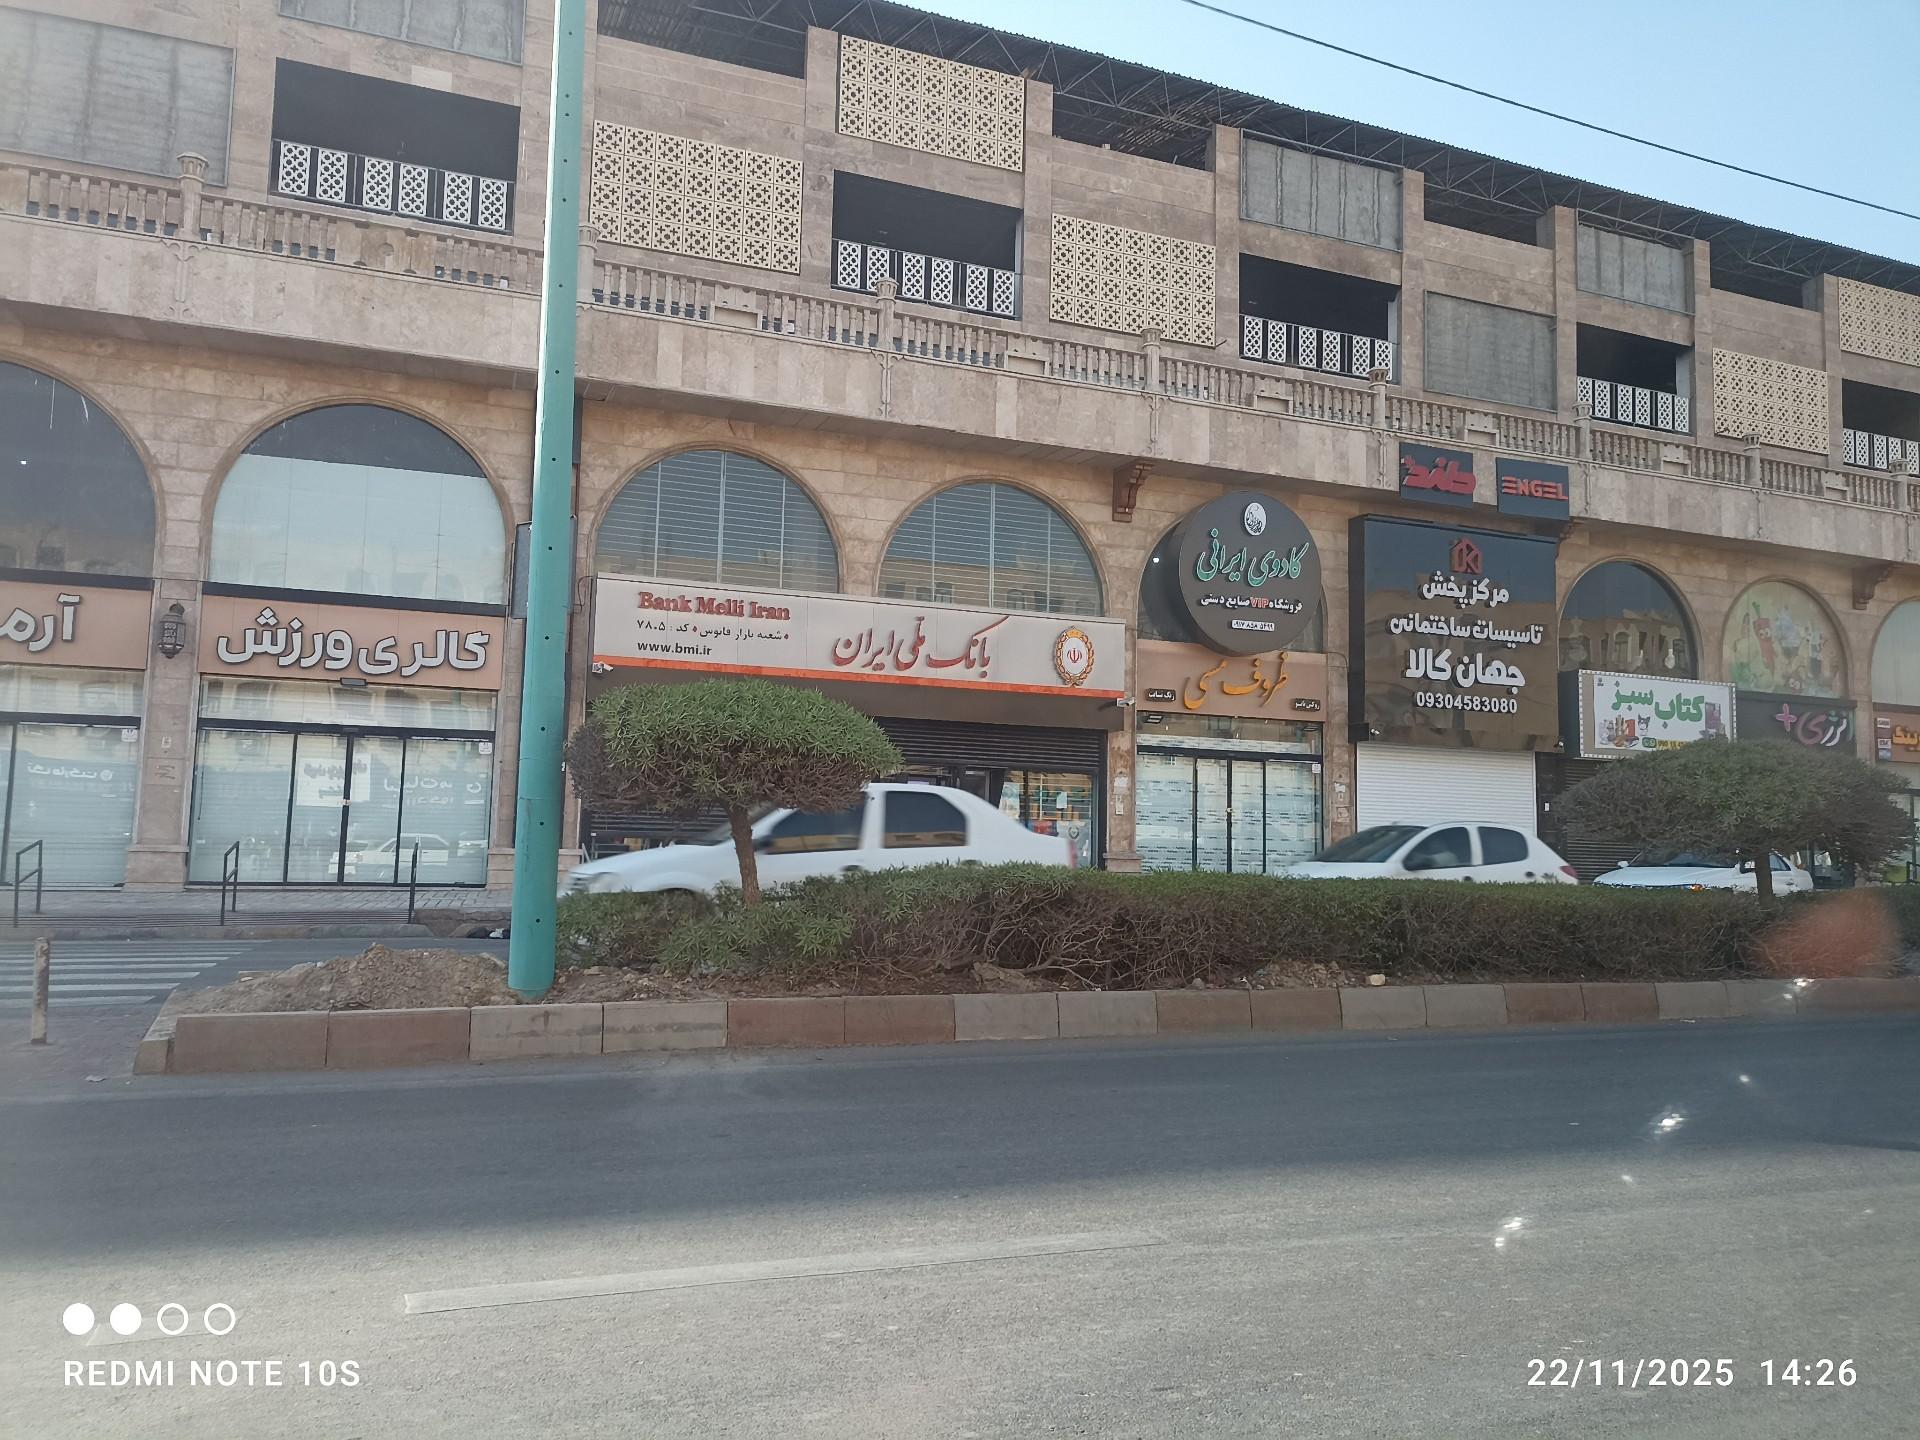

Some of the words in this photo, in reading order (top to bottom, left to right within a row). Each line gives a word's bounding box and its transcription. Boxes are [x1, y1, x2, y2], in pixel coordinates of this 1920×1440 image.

[1502, 476, 1569, 500] ENGEL
[1197, 528, 1247, 581] ایرانی
[1247, 542, 1310, 587] کادوی
[1201, 593, 1225, 605] دستی
[1422, 570, 1468, 608] پخش
[1469, 578, 1510, 607] مرکز
[637, 591, 692, 613] Bank
[694, 596, 745, 618] Melli
[748, 601, 791, 621] Iran
[1269, 598, 1302, 613] فروشگاه
[0, 592, 81, 652] آرم
[676, 623, 689, 632] کد
[699, 626, 731, 638] فانوس
[757, 630, 782, 641] شعبه
[1390, 612, 1471, 638] ساختمانی
[1473, 619, 1544, 648] تاسیسات
[217, 606, 353, 671] ورزش
[637, 641, 712, 656] www.bmi.ir
[832, 627, 895, 671] ایران
[926, 615, 1010, 678] بانک
[1221, 651, 1289, 707] ظروف
[1405, 647, 1453, 681] کالا
[1456, 653, 1526, 694] جهان
[1416, 691, 1518, 713] 09304583080
[1611, 680, 1654, 711] سبز
[1654, 692, 1705, 729] کتاب
